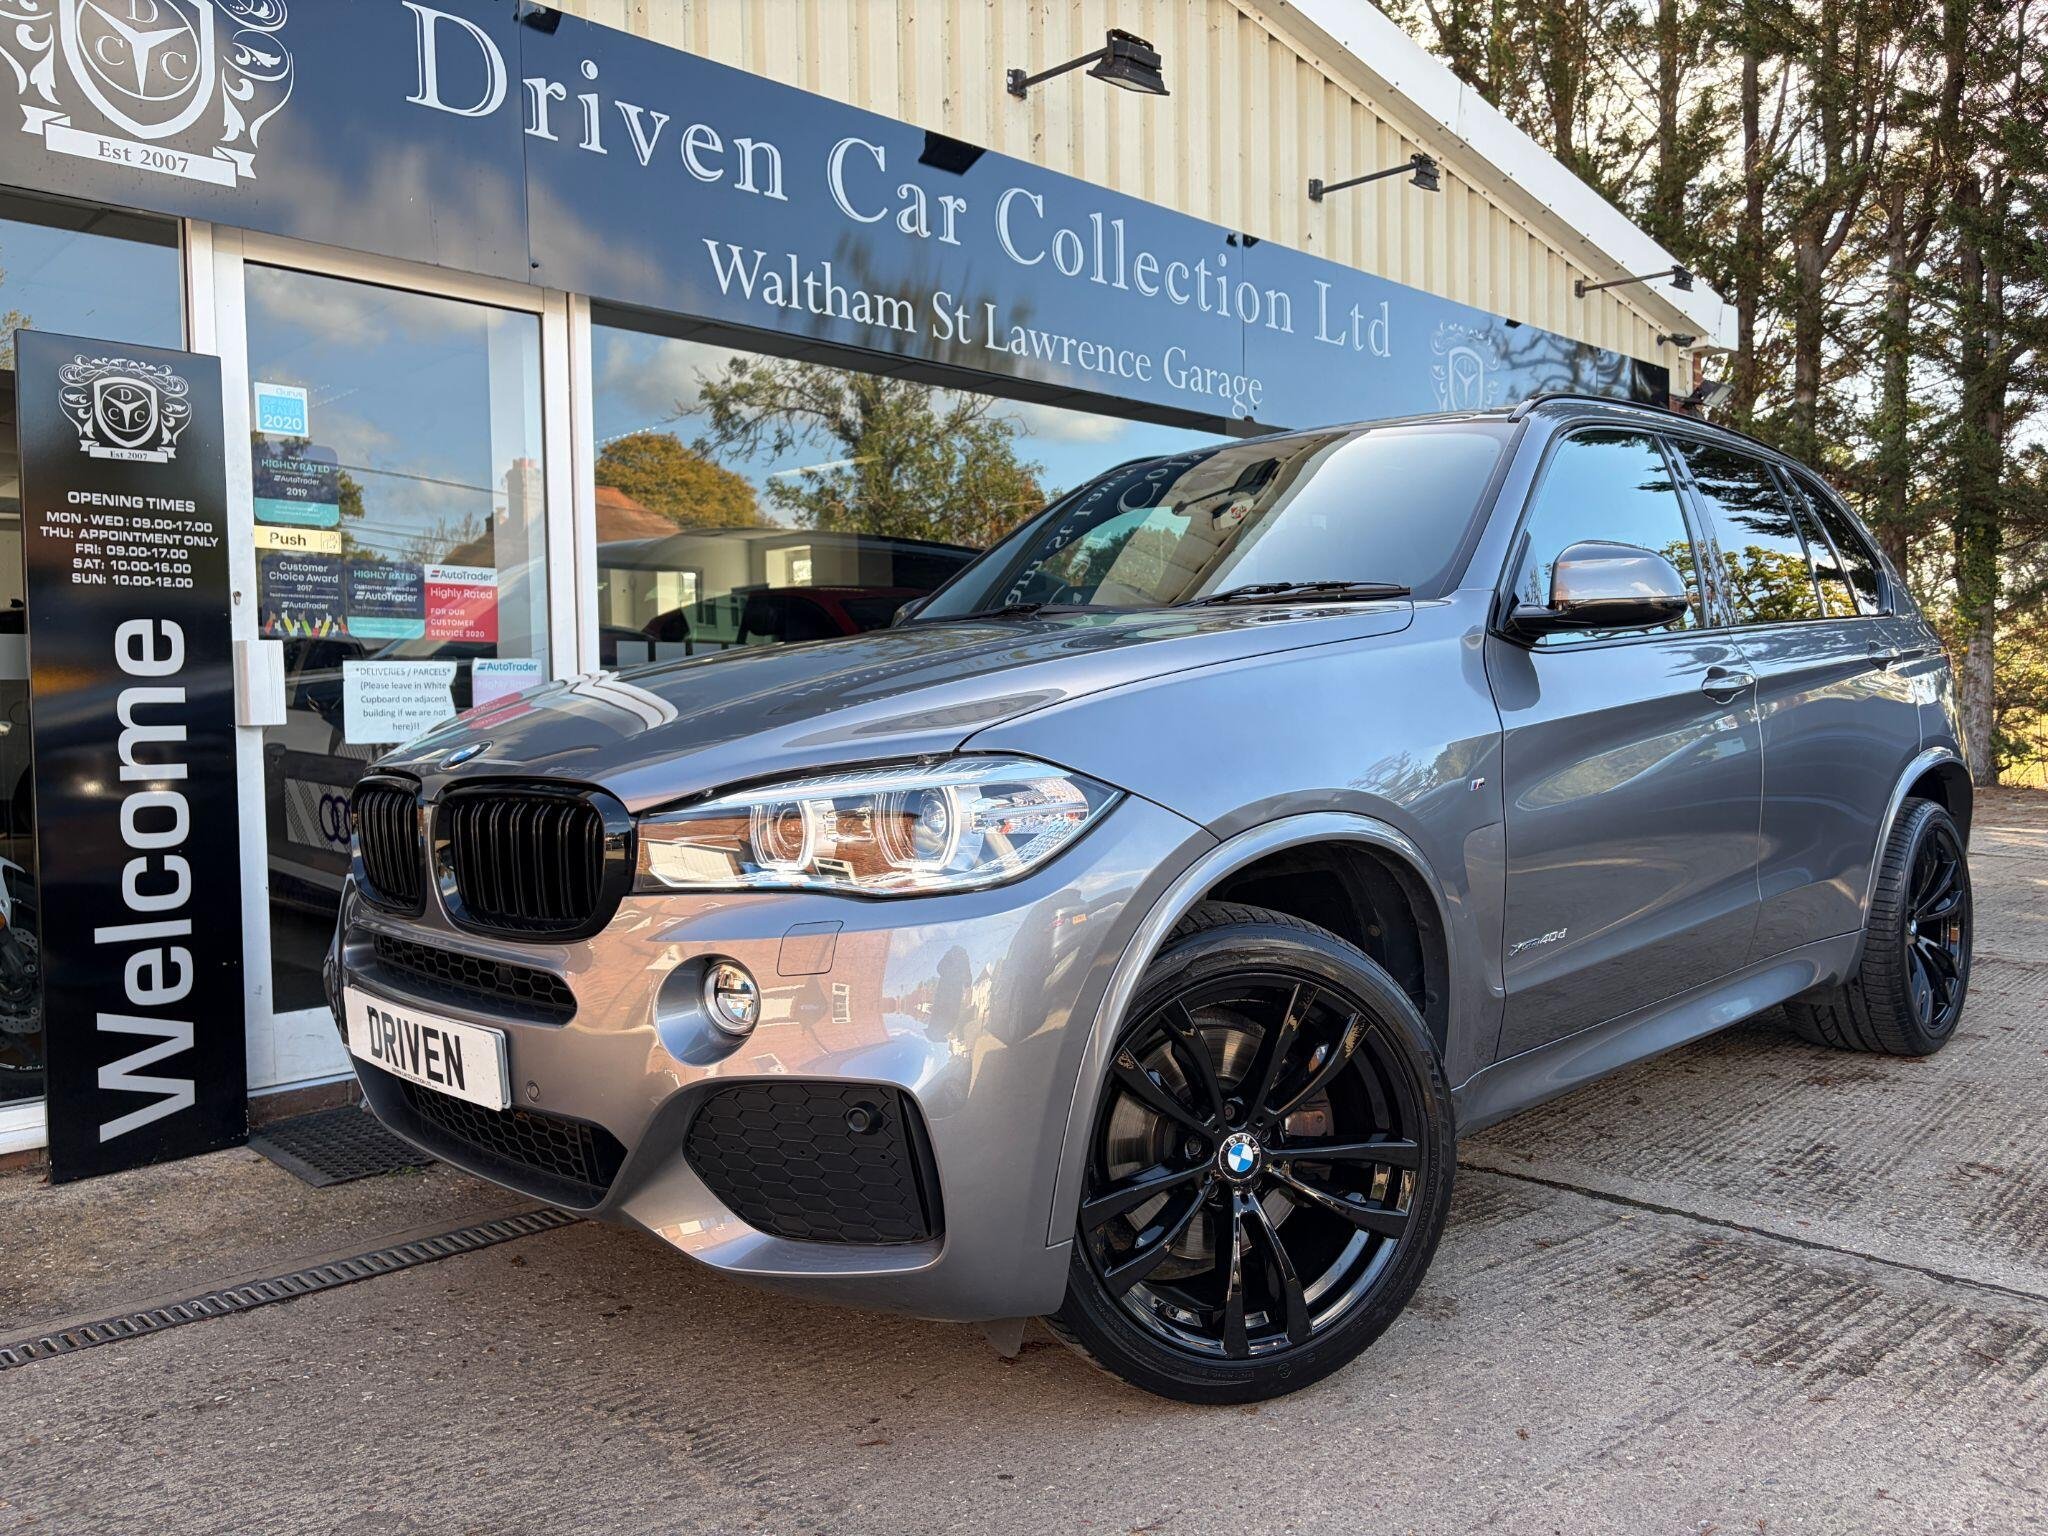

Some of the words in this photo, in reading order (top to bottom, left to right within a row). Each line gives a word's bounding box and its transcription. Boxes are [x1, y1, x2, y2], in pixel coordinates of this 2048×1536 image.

[97, 140, 132, 162] Est
[140, 149, 189, 173] 2007
[405, 3, 788, 201] Driven
[826, 137, 967, 246] Car
[995, 187, 1294, 335] Collection
[1314, 280, 1391, 358] Ltd
[702, 238, 917, 335] Waltham
[932, 291, 972, 344] St
[985, 302, 1152, 382] Lawrence
[1163, 346, 1264, 420] Garage
[263, 414, 303, 431] 2020
[110, 451, 124, 459] Est
[127, 452, 149, 461] 2007
[261, 458, 298, 470] HIGHLY
[299, 463, 330, 474] RATED
[281, 475, 320, 486] AutoTrader
[286, 487, 308, 497] 2019
[67, 491, 143, 509] OPENING
[146, 497, 196, 513] TIMES
[46, 511, 81, 524] MON
[132, 518, 213, 533] 09.00-17.00
[40, 525, 74, 539] THU:
[78, 528, 182, 545] APPOINTMENT
[183, 535, 219, 549] ONLY
[269, 531, 307, 547] Push
[75, 543, 101, 555] FRI:
[106, 545, 188, 560] 09.00-17.00
[72, 558, 105, 570] SAT:
[110, 560, 192, 575] 10.00-16.00
[279, 561, 329, 573] Customer
[71, 572, 107, 585] SUN:
[112, 574, 194, 589] 10.00-12.00
[268, 571, 305, 582] Choice
[306, 573, 339, 584] Award
[353, 569, 387, 580] HIGHLY
[388, 571, 417, 581] RATED
[440, 570, 494, 581] AutoTrader
[296, 584, 313, 592] 2017
[430, 587, 462, 600] Highly
[463, 589, 493, 600] Rated
[365, 591, 418, 604] AutoTrader
[289, 600, 329, 610] AutoTrader
[430, 607, 447, 615] FOR
[448, 608, 465, 616] OUR
[430, 618, 474, 627] CUSTOMER
[430, 629, 464, 638] SERVICE
[465, 630, 485, 639] 2020
[487, 662, 538, 672] AutoTrader
[360, 681, 390, 691] (Please
[391, 681, 413, 690] leave
[414, 681, 422, 690] in
[423, 681, 447, 690] White
[360, 695, 400, 705] Cupboard
[414, 695, 447, 705] adjacent
[363, 708, 396, 718] building
[397, 708, 403, 716] if
[433, 708, 446, 716] not
[94, 617, 196, 1144] Welcome
[366, 1005, 466, 1091] DRIVEN
